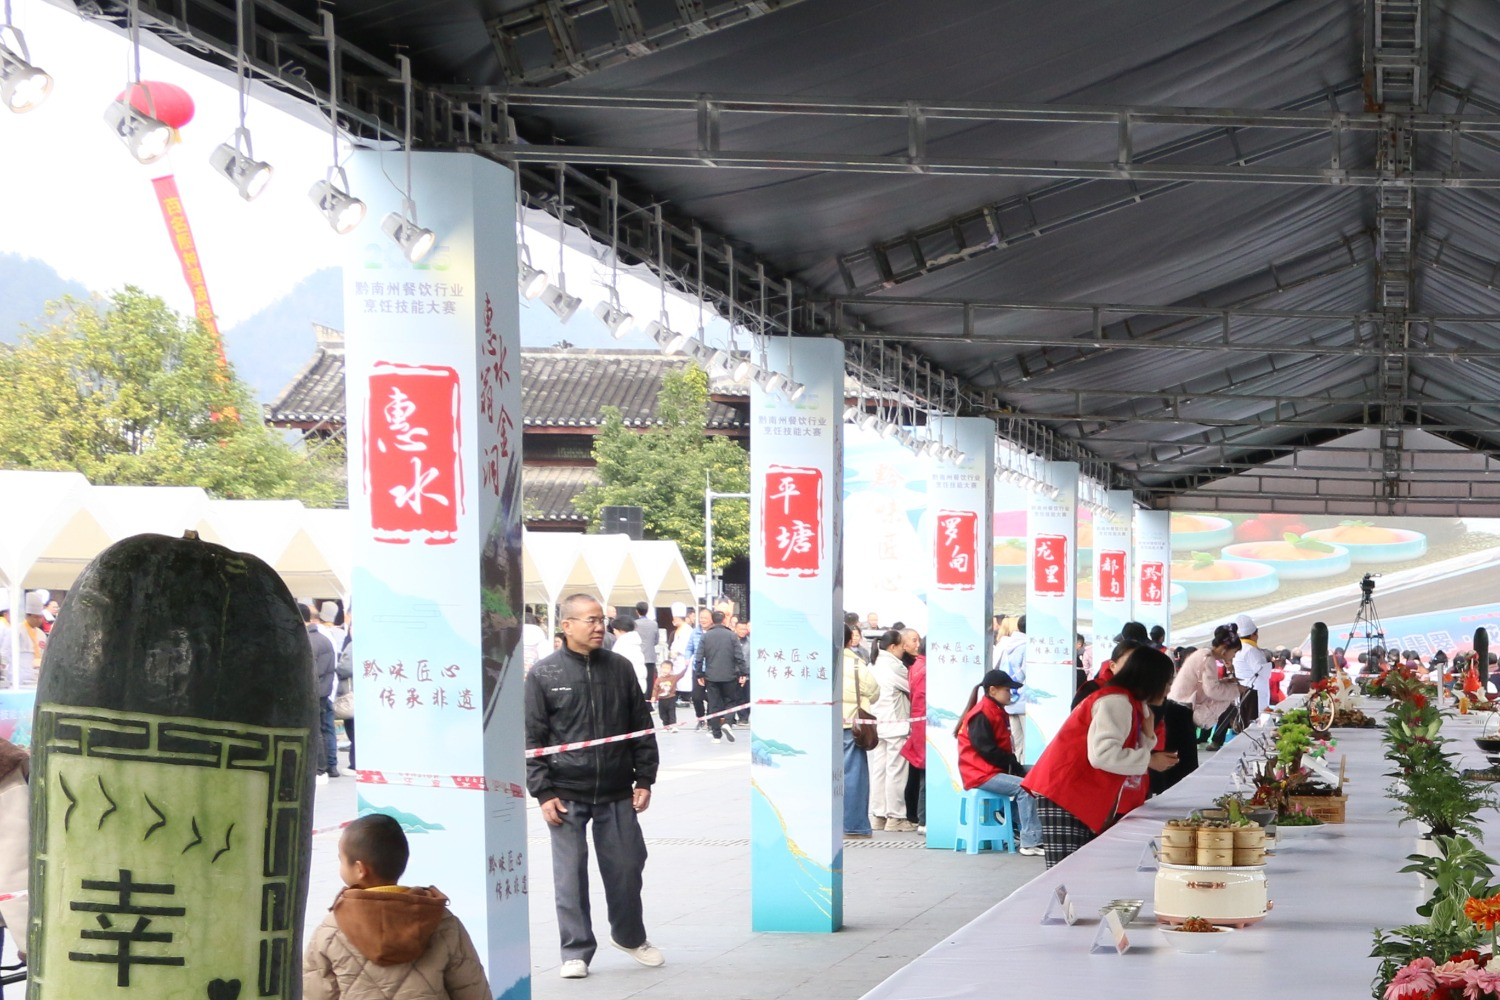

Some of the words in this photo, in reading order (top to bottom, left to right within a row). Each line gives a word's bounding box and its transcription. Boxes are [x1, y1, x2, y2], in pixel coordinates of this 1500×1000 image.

[354, 281, 465, 298] 黔南州餐饮行业
[363, 299, 457, 315] 烹饪技能大赛
[758, 415, 827, 427] 黔南州餐饮行业
[763, 426, 822, 437] 烹饪技能大赛
[377, 385, 449, 515] 惠水
[769, 477, 816, 562] 平塘
[940, 517, 969, 572] 罗甸
[1036, 540, 1060, 584] 龙里
[1101, 557, 1119, 595] 都匀
[1142, 566, 1162, 600] 黔南
[757, 648, 819, 663] 黔味匠心
[930, 641, 976, 653] 黔味匠心
[937, 654, 982, 666] 传承非遗
[362, 659, 461, 682] 黔味匠心
[767, 665, 829, 681] 传承非遗
[379, 688, 477, 711] 传承非遗
